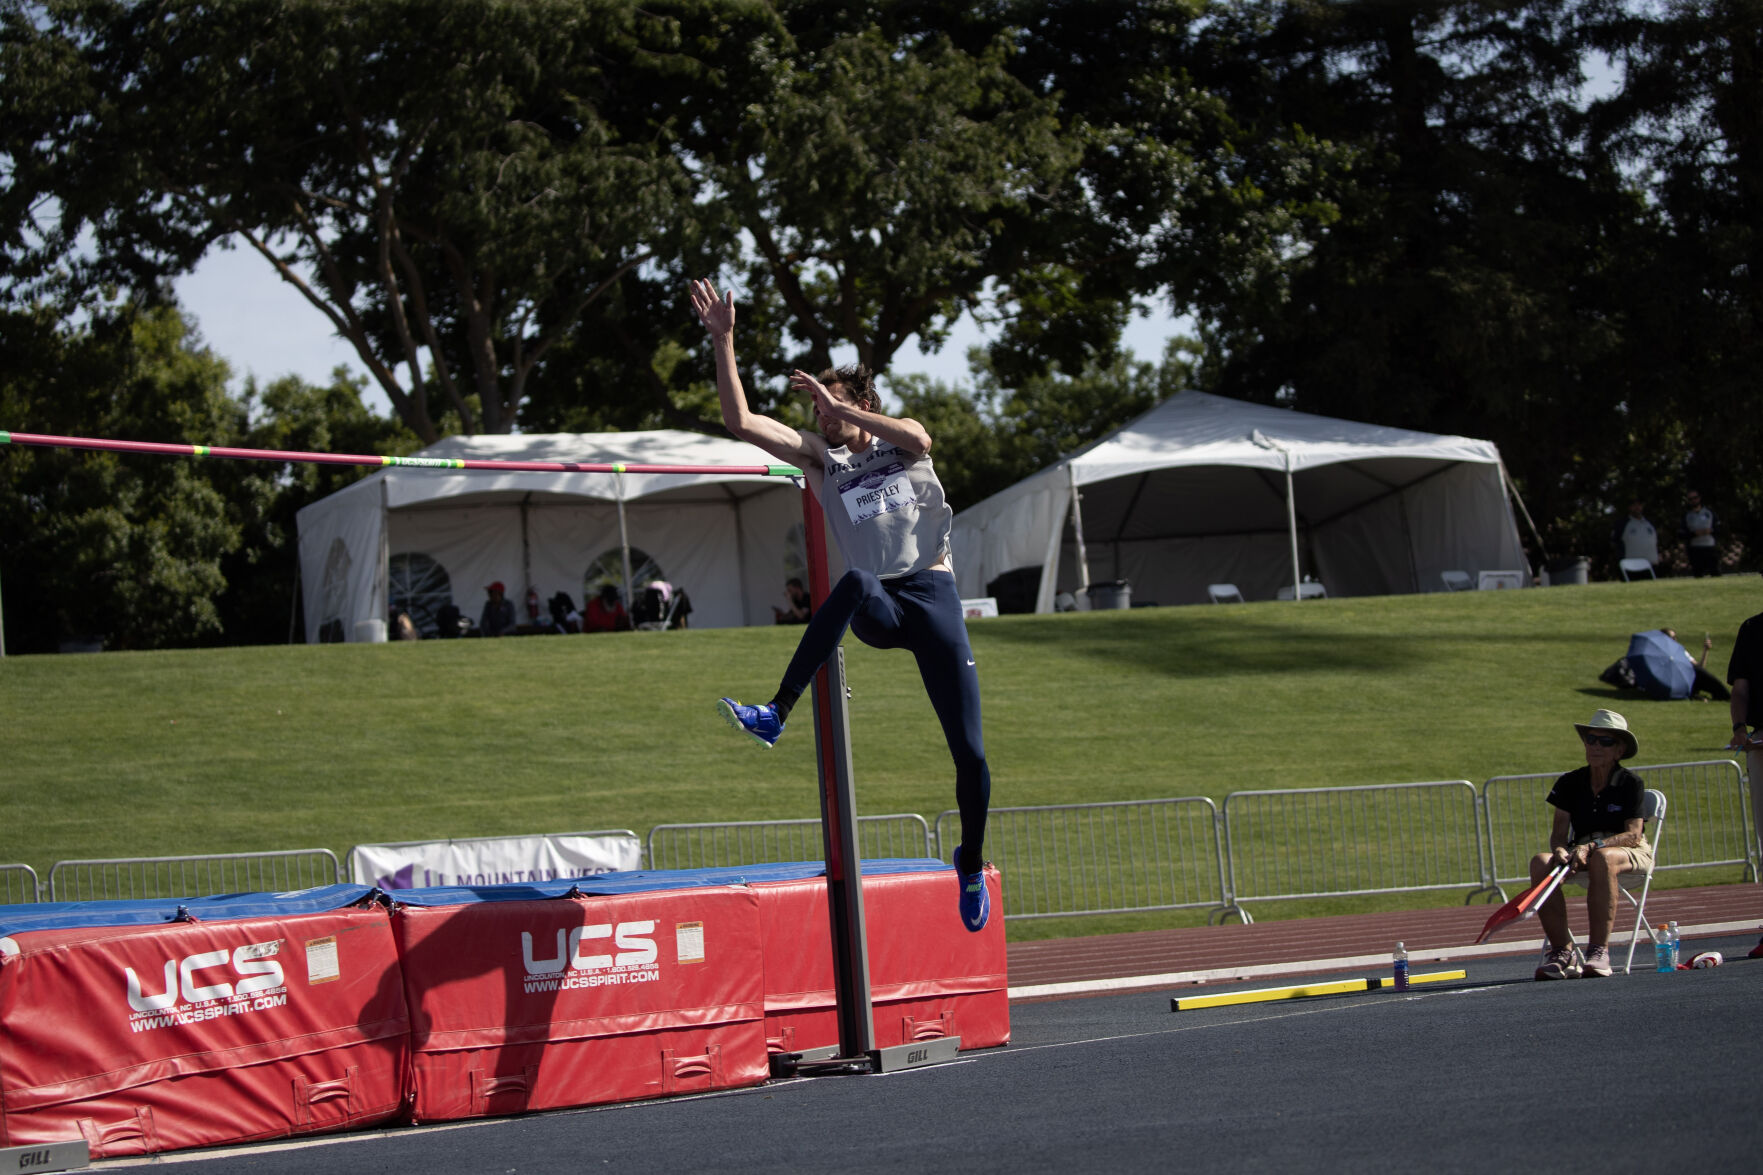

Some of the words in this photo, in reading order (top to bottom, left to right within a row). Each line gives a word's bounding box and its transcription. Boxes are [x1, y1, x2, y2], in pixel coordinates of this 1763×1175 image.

[856, 483, 900, 507] PRIESTLEY
[457, 869, 557, 886] MOUNTAIN
[966, 883, 983, 893] NIKE
[521, 920, 658, 974] UCS
[125, 939, 285, 1011] UCS
[524, 971, 660, 993] WWW.UCSSPIRIT.COM
[130, 994, 287, 1033] WWW.UCSSPIRIT.COM
[907, 1048, 928, 1064] GILL
[19, 1150, 50, 1169] GILL
